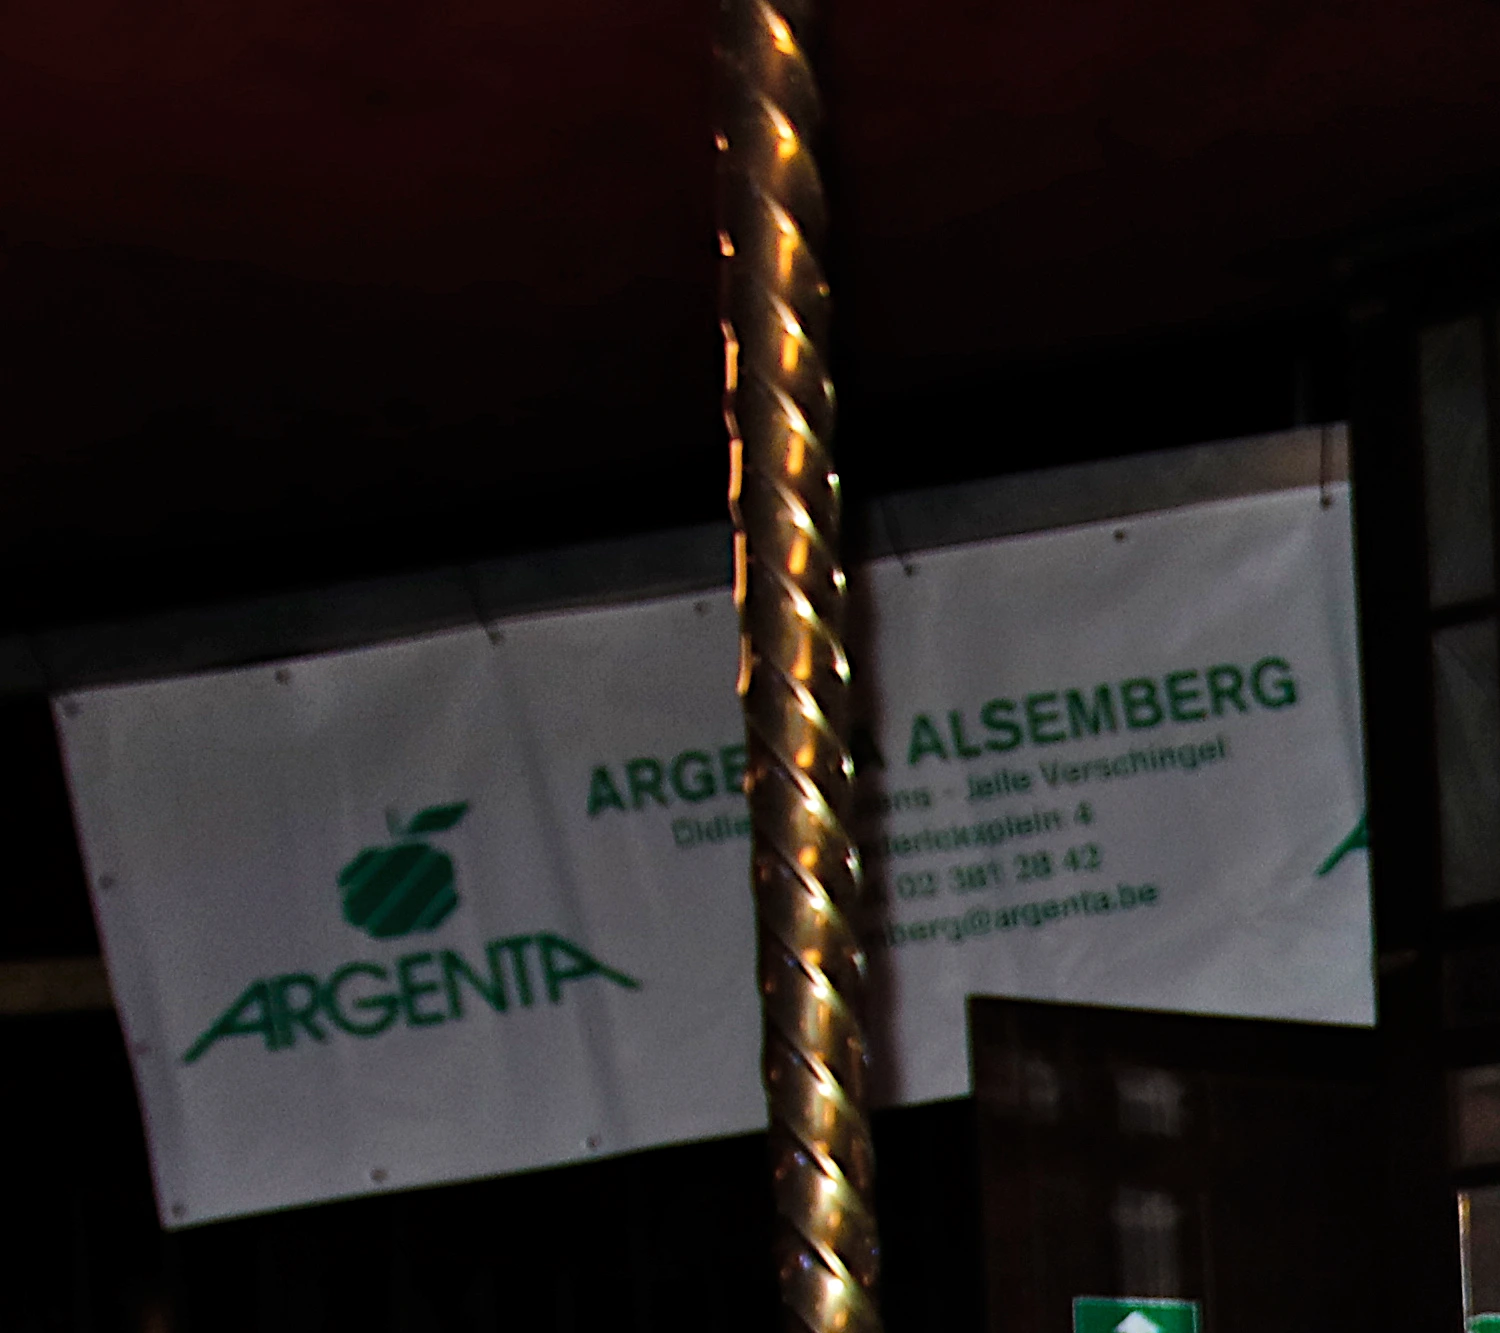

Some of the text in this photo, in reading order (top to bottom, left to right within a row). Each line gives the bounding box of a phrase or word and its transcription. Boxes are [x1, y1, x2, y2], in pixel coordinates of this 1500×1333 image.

[907, 655, 1298, 766] ALSEMBERG
[1073, 801, 1095, 827] 4
[898, 870, 939, 901] 02
[1061, 842, 1103, 874] 42
[883, 879, 1163, 949] berg@argenta.be
[182, 930, 642, 1064] ARGENTA
